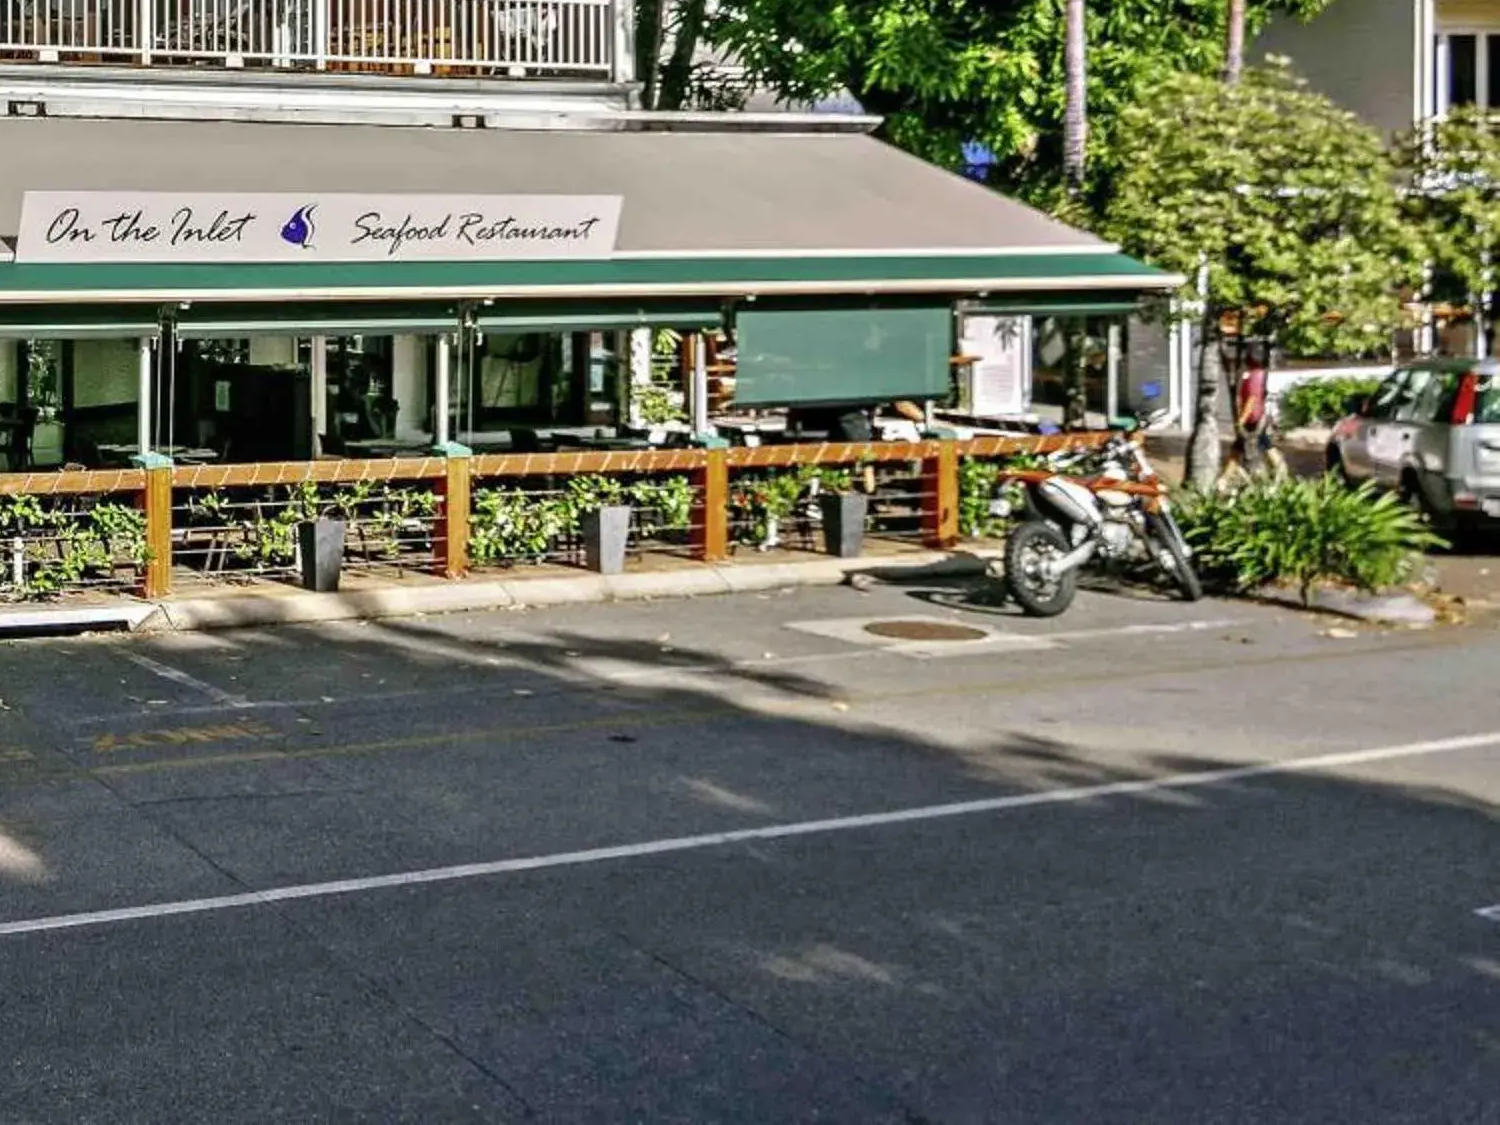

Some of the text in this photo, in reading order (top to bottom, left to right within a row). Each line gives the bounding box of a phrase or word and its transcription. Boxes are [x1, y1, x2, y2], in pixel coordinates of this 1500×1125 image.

[46, 207, 601, 256] On the Inlet Seafood Restaurant
